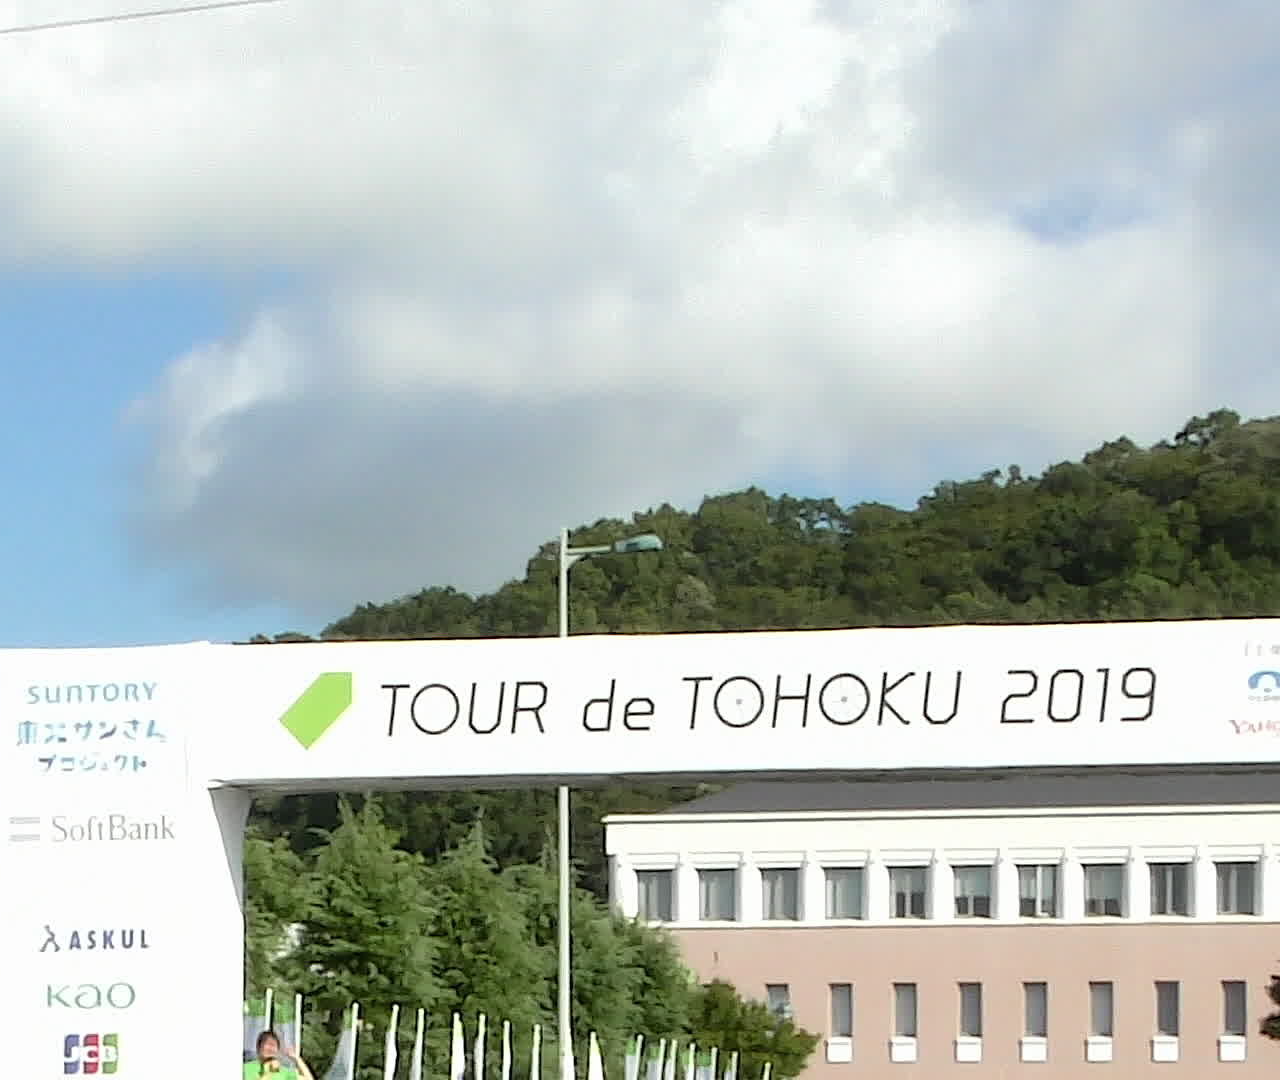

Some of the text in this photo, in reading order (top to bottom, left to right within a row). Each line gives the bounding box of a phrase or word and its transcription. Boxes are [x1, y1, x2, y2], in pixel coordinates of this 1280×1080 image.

[26, 681, 157, 704] SUNTORY
[381, 667, 1157, 736] TOUR de TOHOKU 2019
[52, 814, 175, 842] SoftBank
[69, 929, 150, 950] ASKUL
